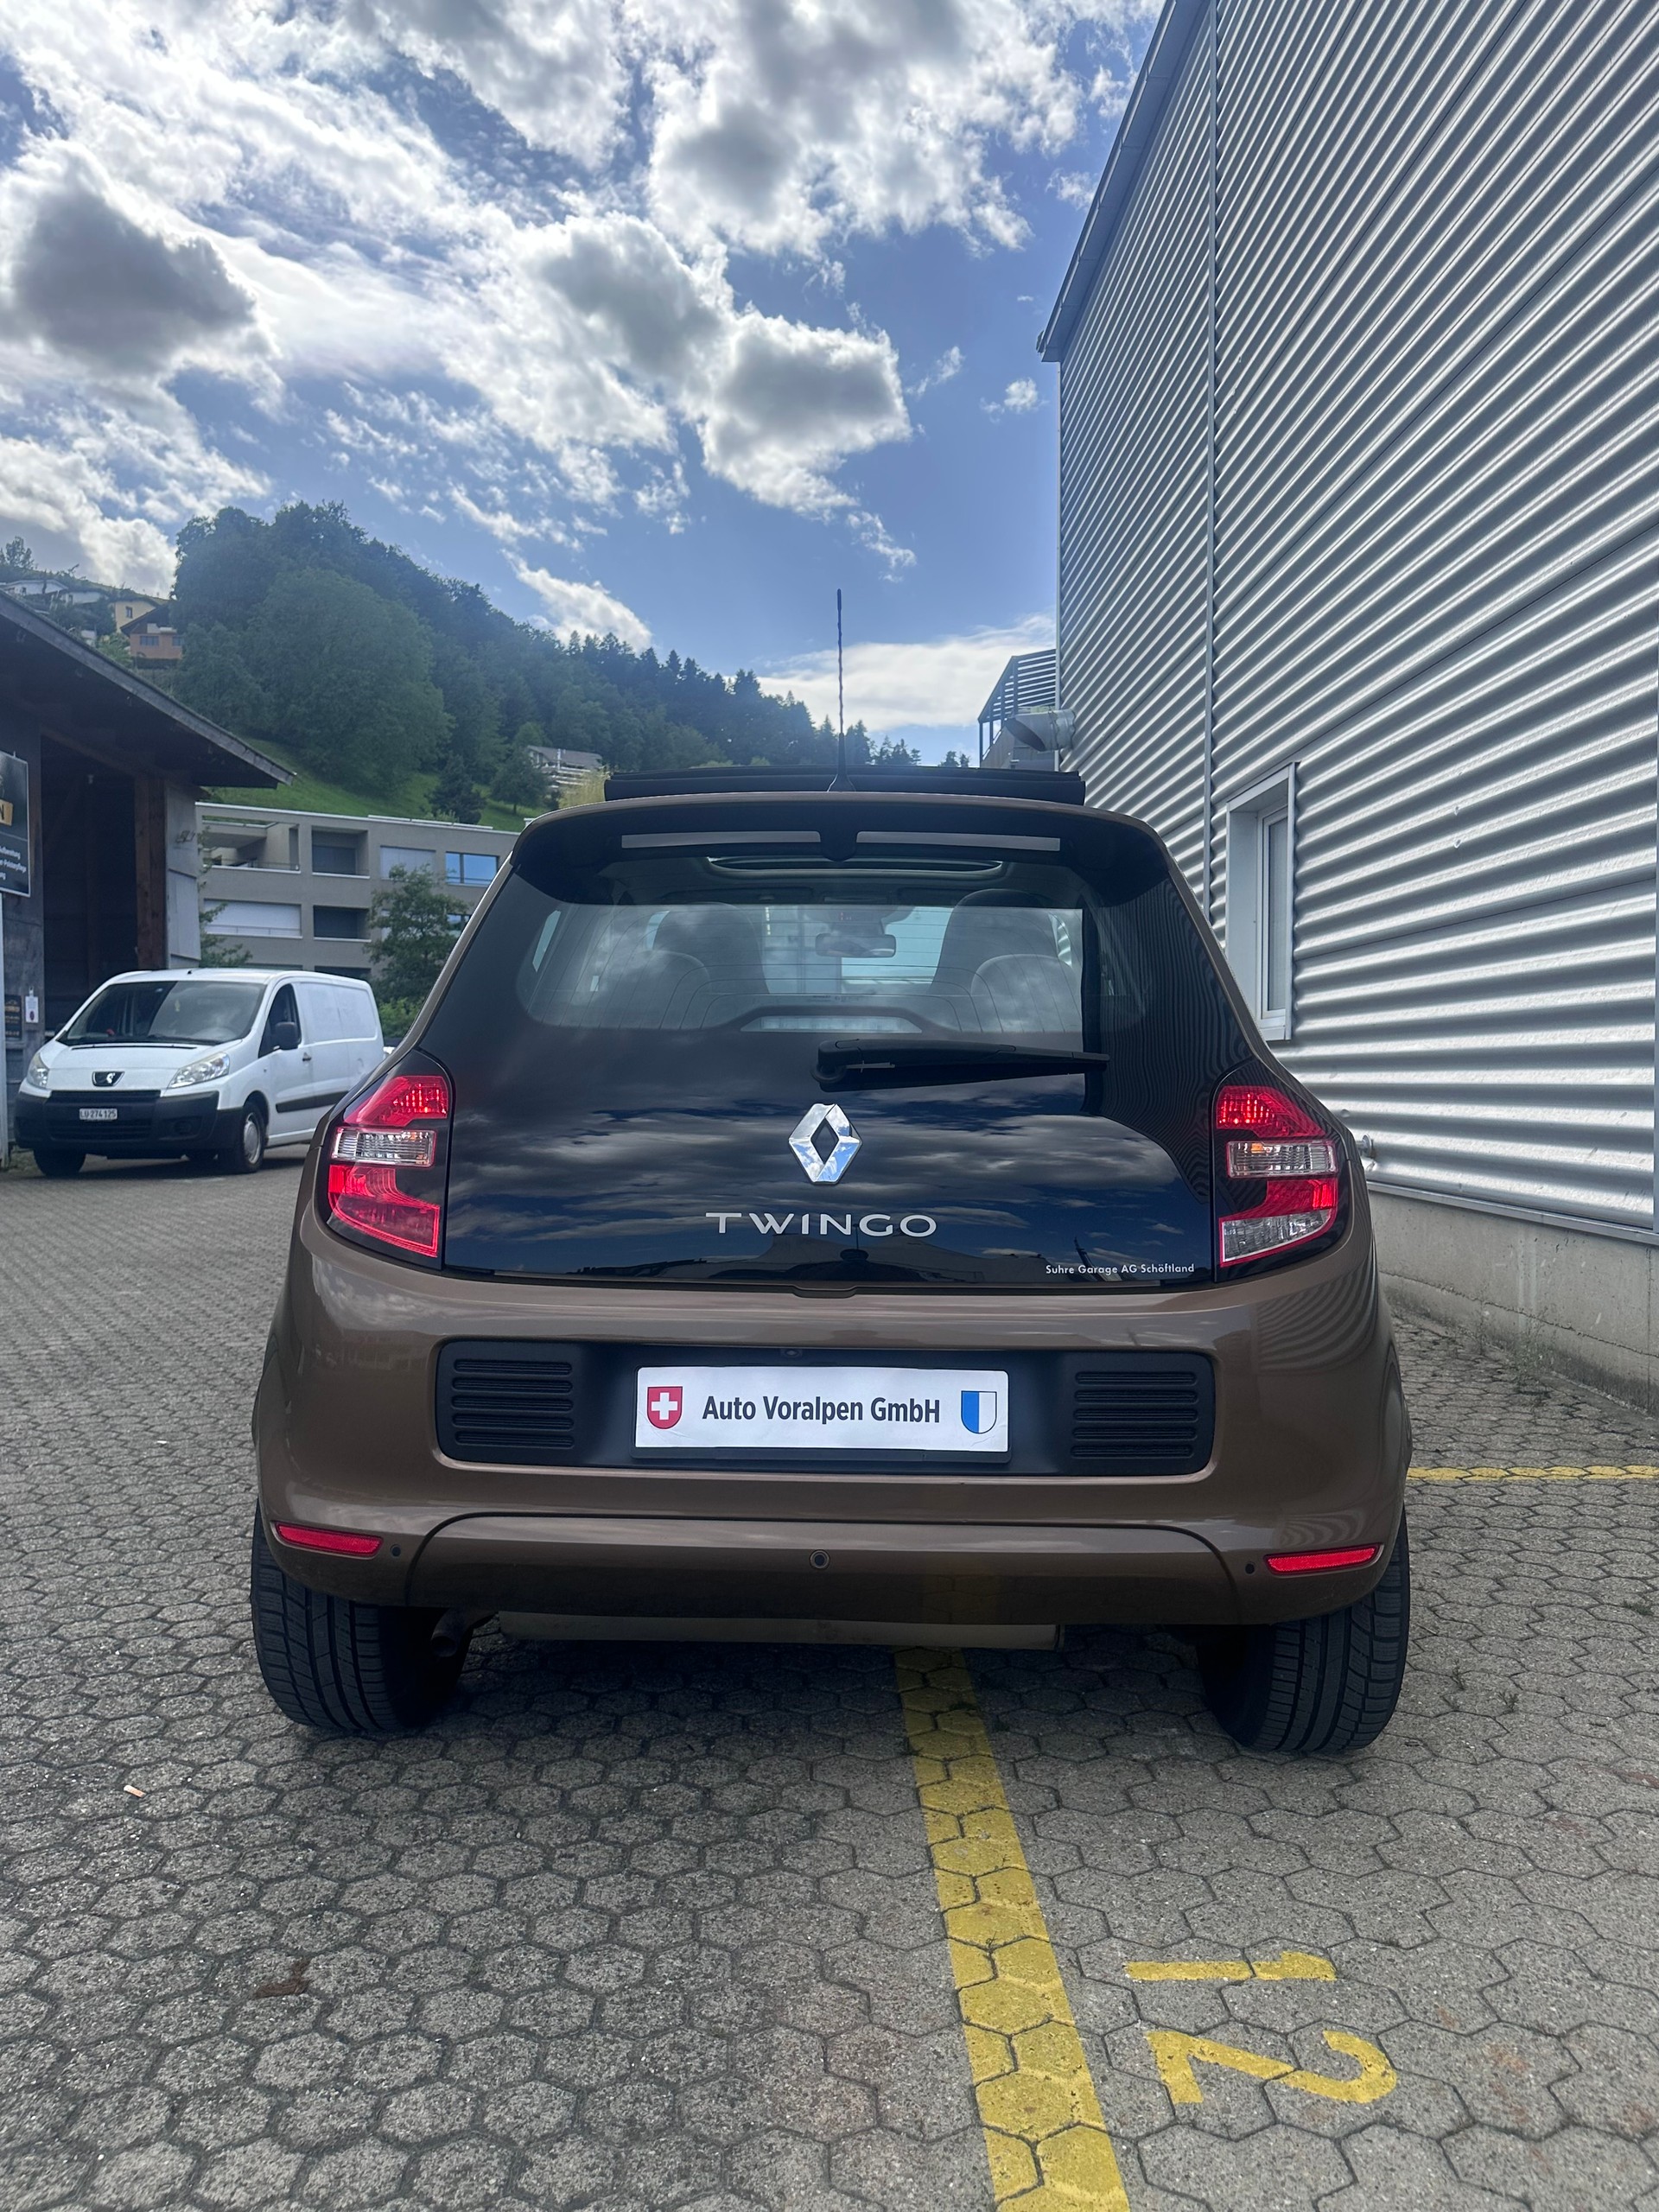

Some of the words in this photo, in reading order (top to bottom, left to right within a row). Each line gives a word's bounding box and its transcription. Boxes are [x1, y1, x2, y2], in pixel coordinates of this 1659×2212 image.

[705, 1212, 937, 1237] TWINGO
[1046, 1264, 1075, 1274] Suhre
[1077, 1264, 1118, 1276] Garage
[1121, 1264, 1138, 1274] AG
[1141, 1263, 1195, 1274] Schöftland
[702, 1395, 757, 1421] Auto
[763, 1395, 863, 1425] Voralpen
[870, 1397, 940, 1423] GmbH
[1124, 1950, 1398, 2105] 12
